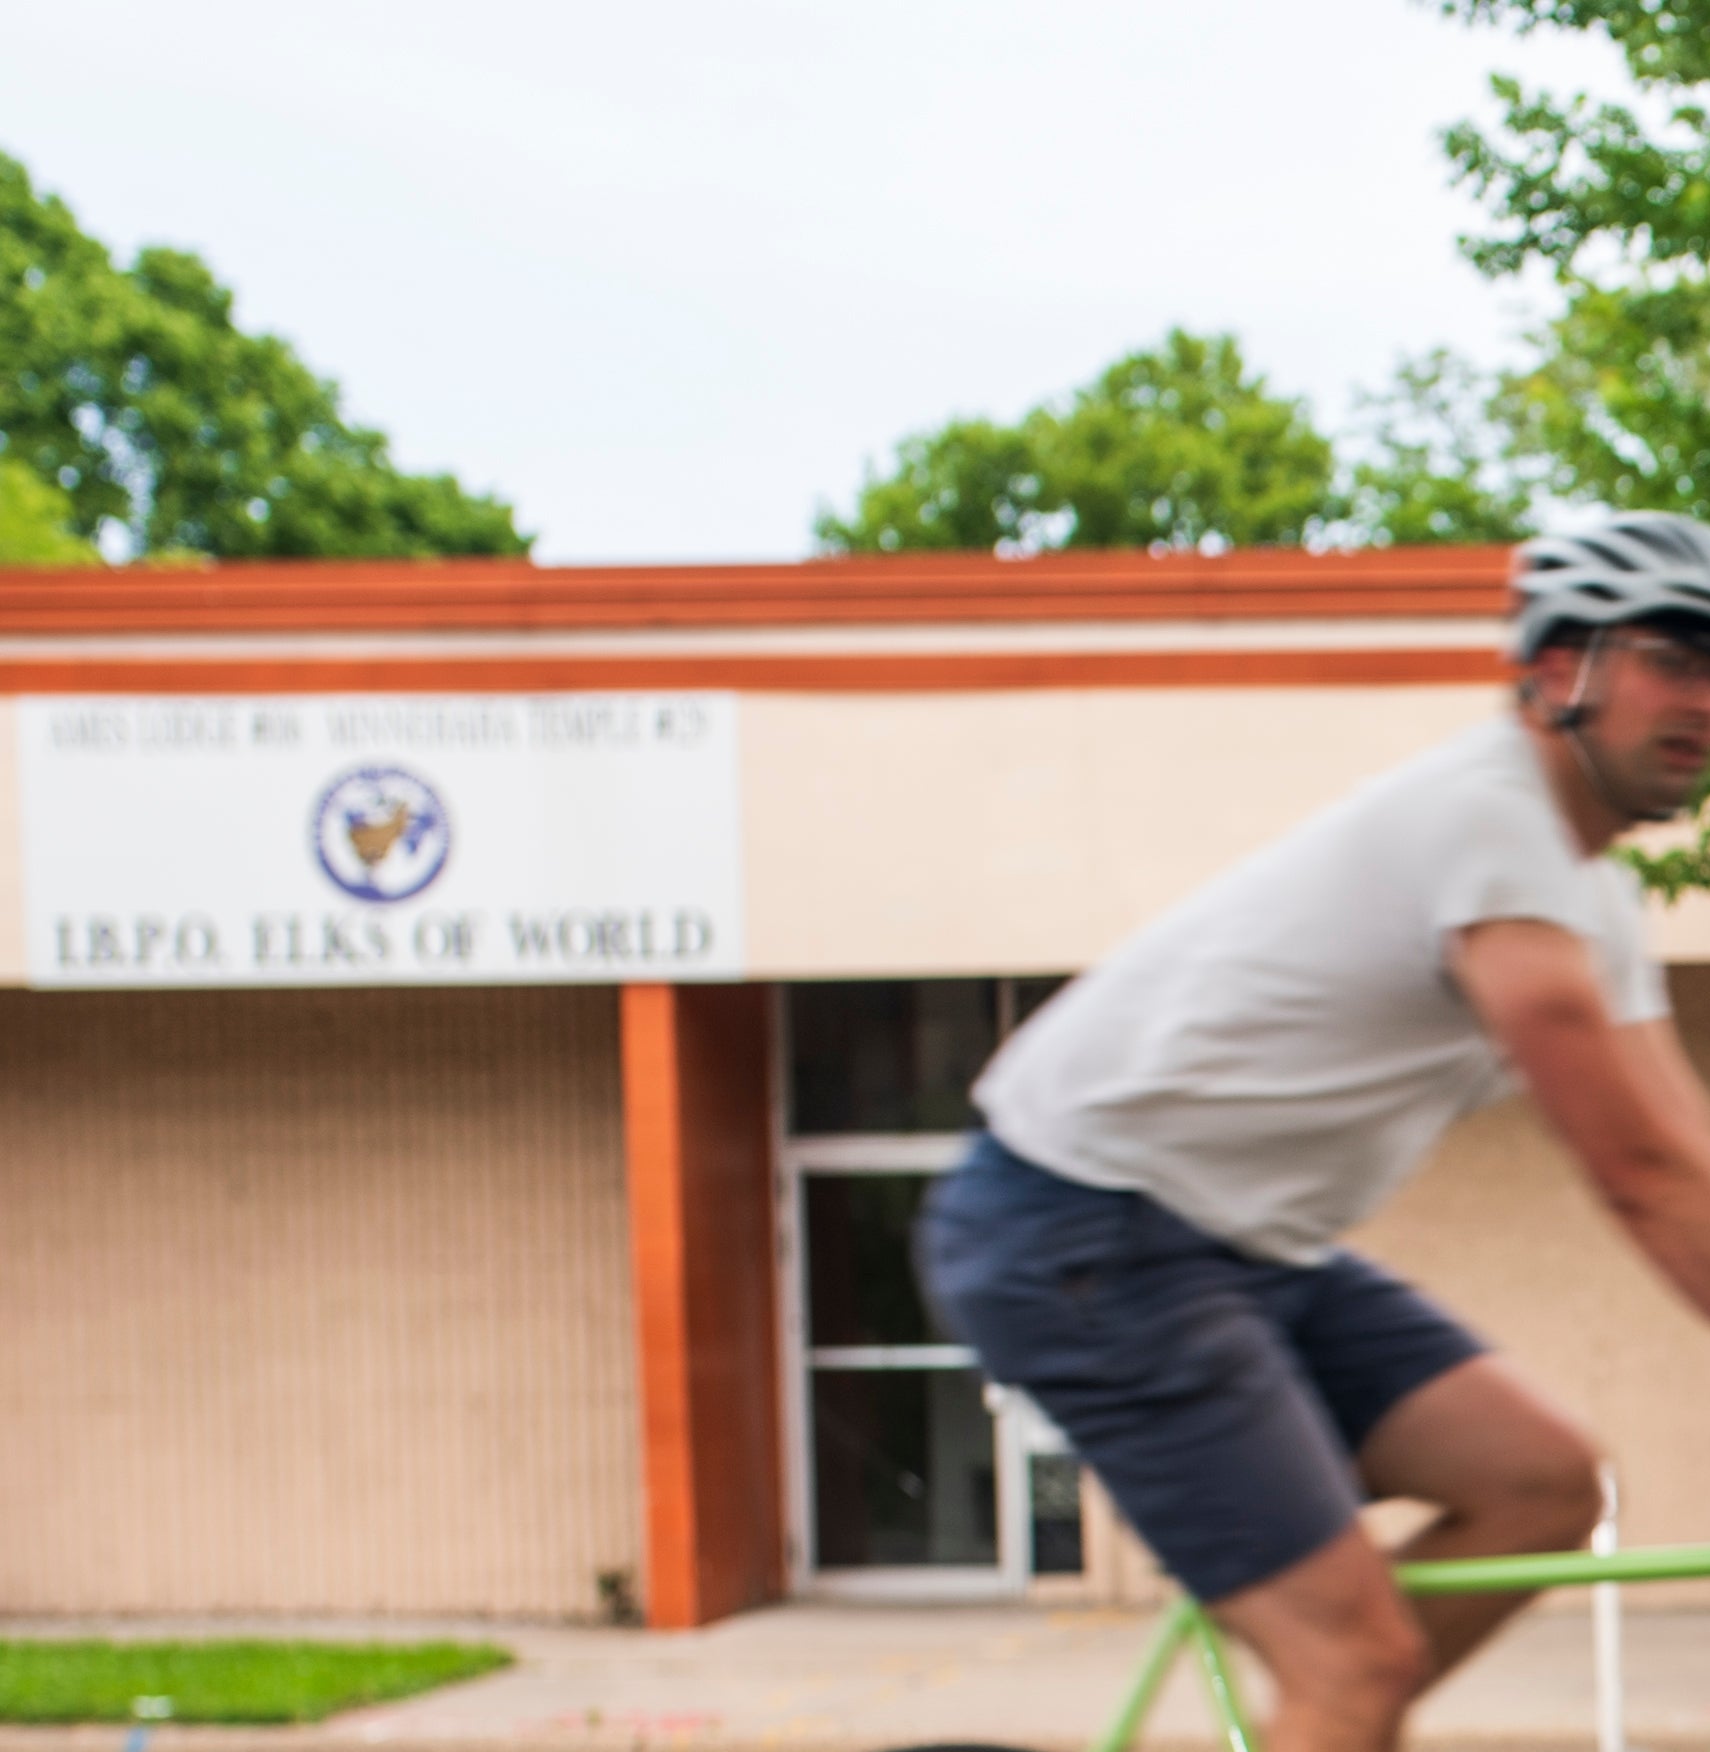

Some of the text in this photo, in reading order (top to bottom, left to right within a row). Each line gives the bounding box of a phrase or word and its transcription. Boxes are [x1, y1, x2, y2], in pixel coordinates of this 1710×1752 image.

[252, 912, 391, 965] ELKS
[412, 910, 481, 962] OF
[509, 907, 713, 959] WORLD
